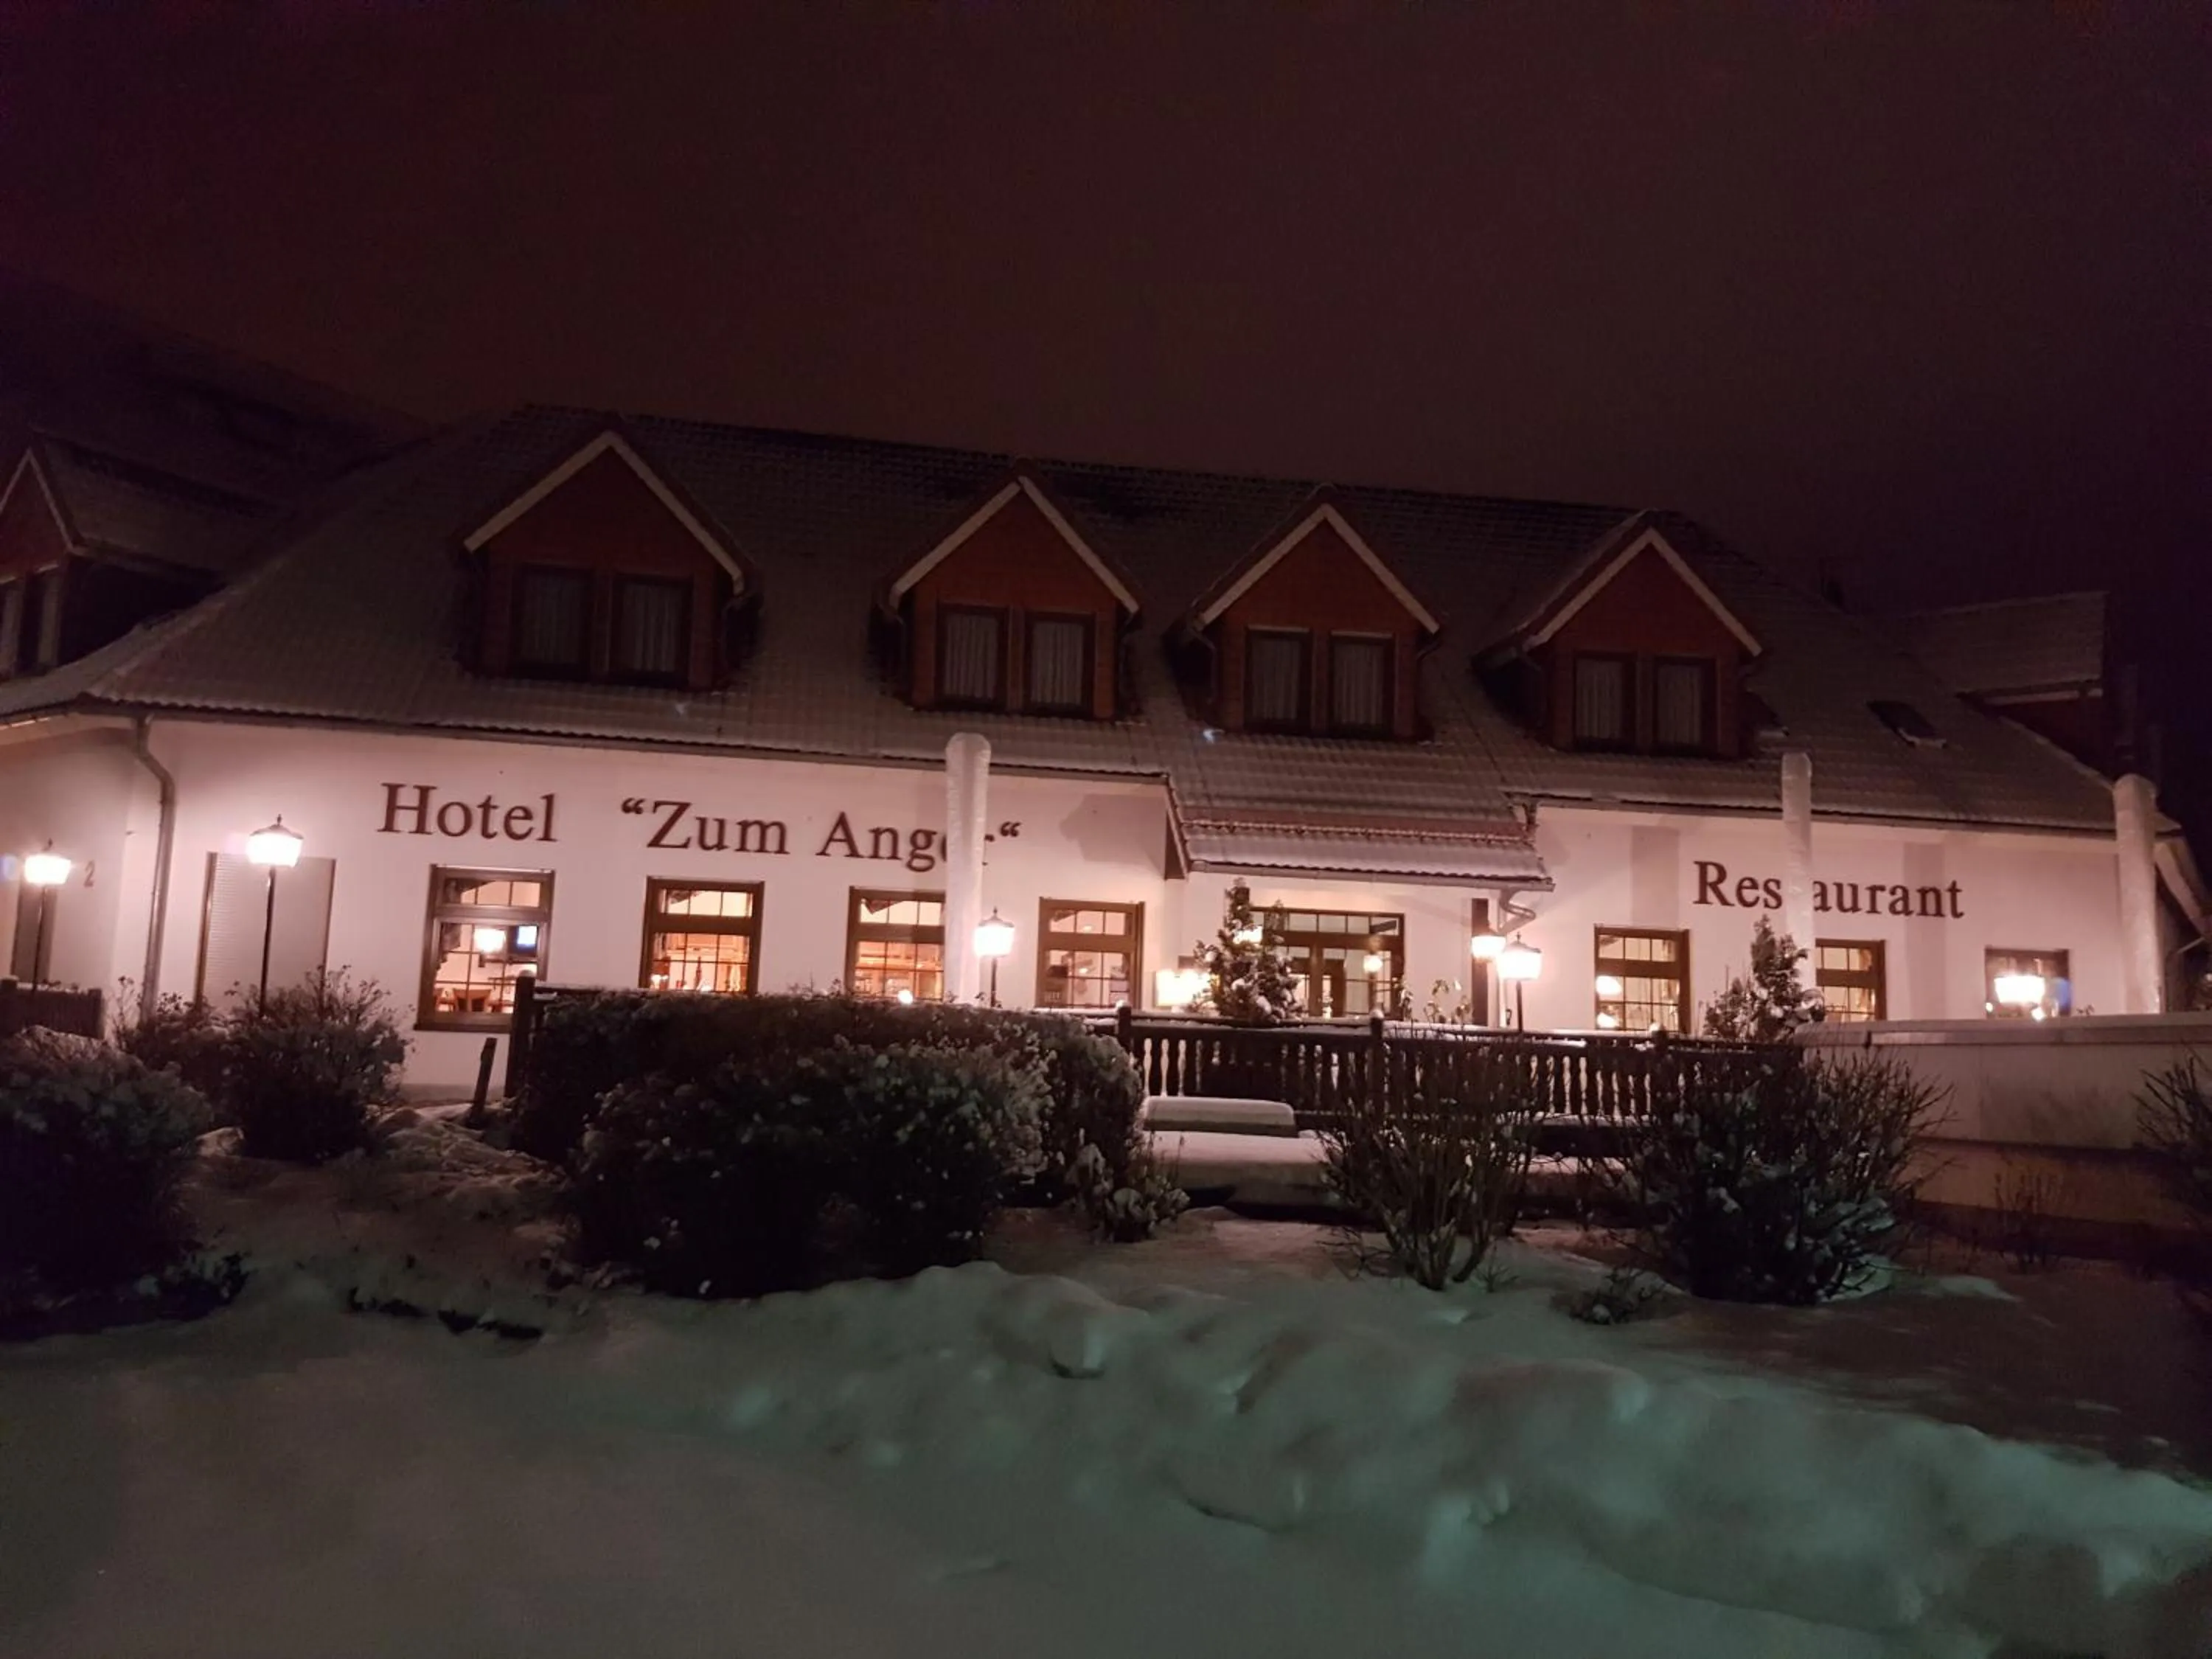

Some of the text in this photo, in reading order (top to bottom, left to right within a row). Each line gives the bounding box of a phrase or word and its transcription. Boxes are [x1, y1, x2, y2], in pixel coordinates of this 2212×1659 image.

[376, 782, 558, 842] Hotel
[815, 811, 1021, 872] Ang“
[1693, 860, 1964, 919] Resaurant
